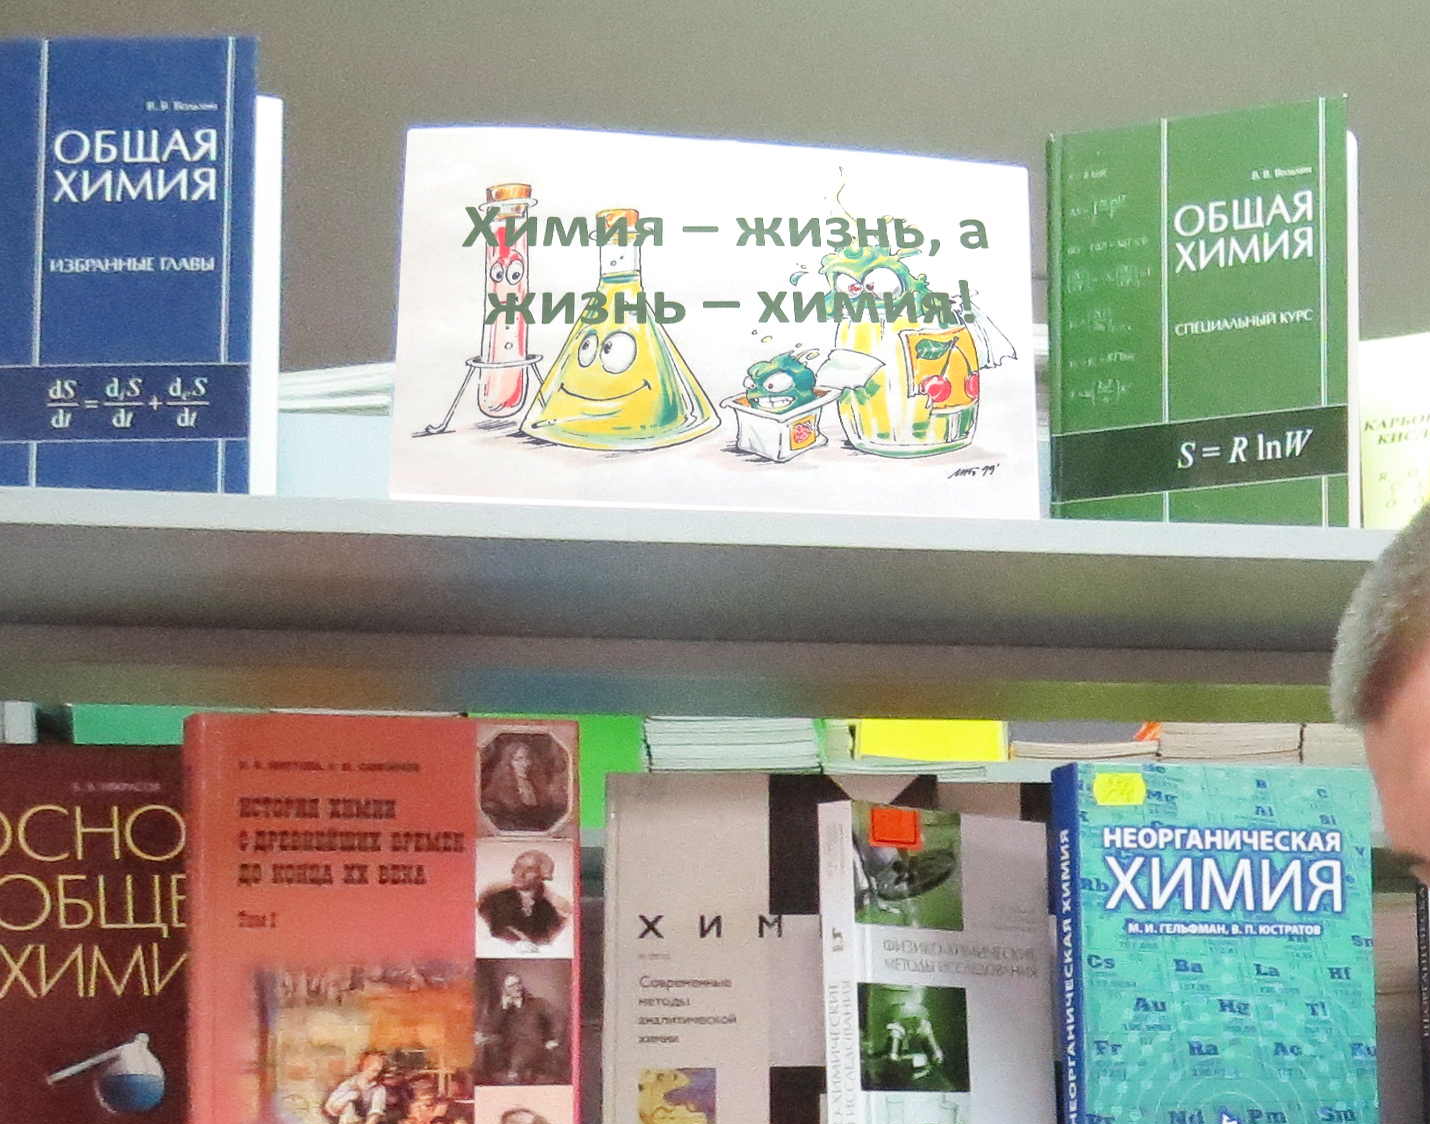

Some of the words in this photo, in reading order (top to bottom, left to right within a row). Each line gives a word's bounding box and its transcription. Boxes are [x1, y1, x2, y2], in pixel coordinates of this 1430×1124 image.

[54, 129, 217, 164] ОБЩАЯ
[53, 167, 216, 202] ХИМИЯ
[1174, 190, 1314, 237] ОБЩАЯ
[462, 206, 664, 248] Химия
[735, 215, 940, 256] жизнь,
[960, 218, 990, 250] а
[50, 257, 154, 273] ИЗБРАННЫЕ
[160, 257, 215, 272] ГЛАВЫ
[1175, 226, 1314, 274] ХИМИЯ
[485, 290, 687, 325] жизнь
[758, 280, 974, 325] химия!
[1175, 312, 1277, 337] СПЕЦИАЛЬНЫЙ
[1280, 308, 1314, 323] КУРС
[1103, 826, 1342, 853] НЕОРГАНИЧЕСКАЯ
[238, 862, 262, 886] ДО
[272, 863, 334, 886] КОНЦА
[378, 863, 428, 886] ВЕКА
[1060, 828, 1072, 913] ХИМИЯ
[1104, 855, 1343, 913] ХИМИЯ
[1159, 922, 1229, 936] ГЕЛЬФМАН,
[1258, 922, 1322, 936] ЮСТРАТОВ
[638, 974, 733, 993] Современные
[638, 996, 691, 1008] методы
[638, 1012, 738, 1026] аналитической
